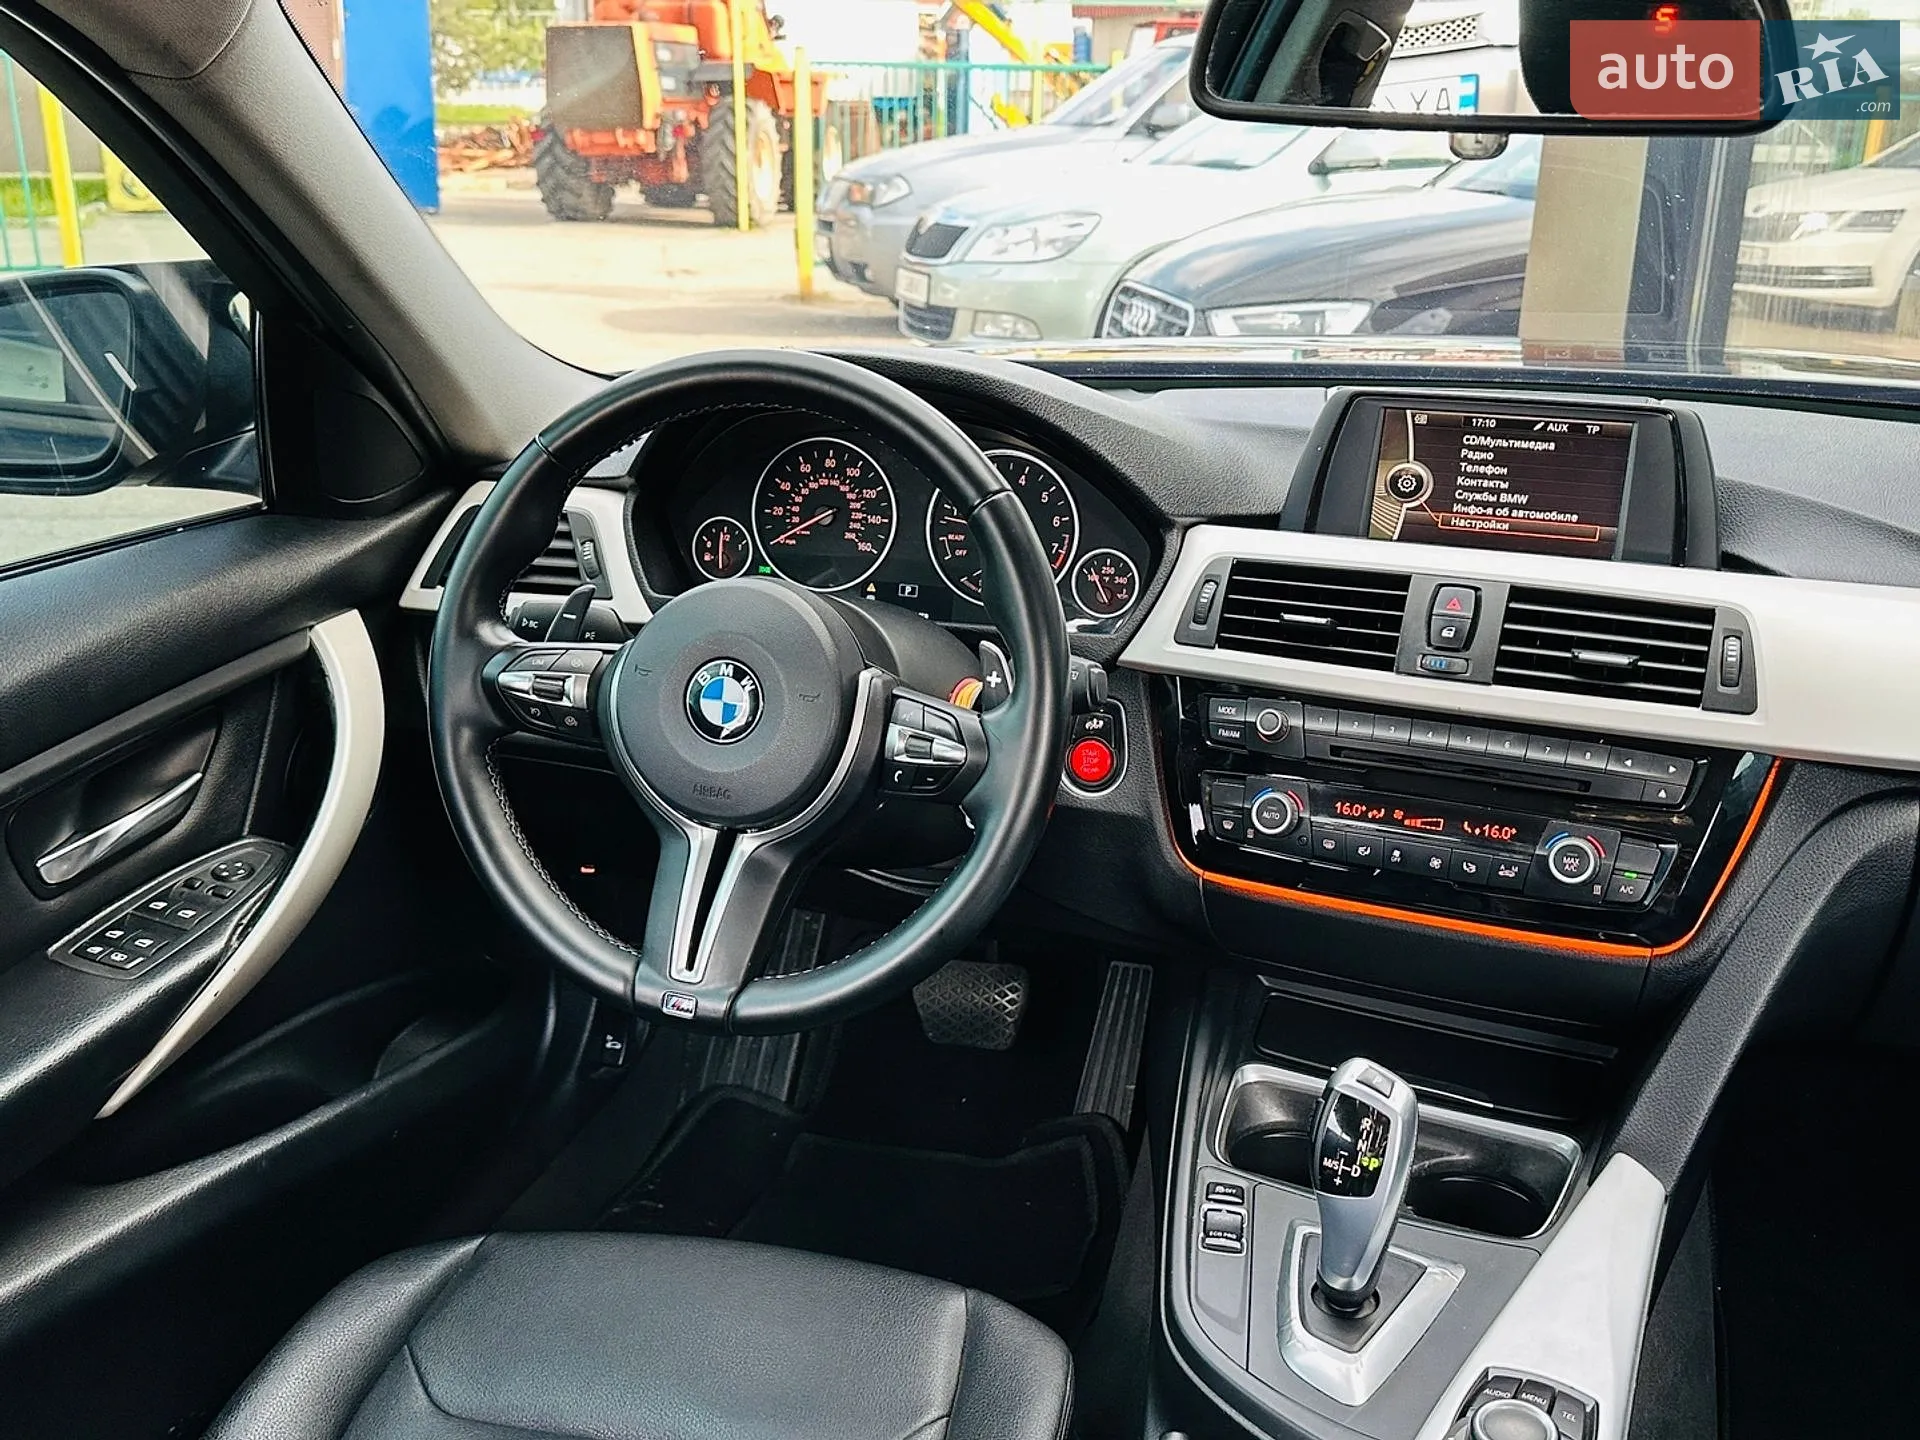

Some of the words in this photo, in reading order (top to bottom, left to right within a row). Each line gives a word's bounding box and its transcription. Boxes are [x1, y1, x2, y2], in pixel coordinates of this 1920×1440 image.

[1472, 418, 1496, 428] 17:10
[1547, 424, 1568, 433] AUX
[1586, 425, 1600, 434] TP
[1463, 435, 1556, 451] CD/Мультимедиа
[1461, 450, 1494, 461] Радио
[800, 464, 811, 472] 60
[824, 459, 836, 468] 80
[1460, 462, 1508, 476] Телефон
[846, 468, 860, 477] 100
[1019, 475, 1026, 486] 4
[1457, 476, 1509, 490] Контакты
[780, 482, 791, 491] 40
[863, 489, 876, 498] 120
[1041, 492, 1049, 502] 5
[1455, 490, 1498, 504] Службы
[1500, 492, 1528, 505] BMW
[772, 507, 783, 516] 20
[1453, 503, 1494, 517] Инфо-я
[1497, 506, 1509, 517] об
[1511, 510, 1578, 523] автомобиле
[867, 515, 881, 524] 140
[1053, 516, 1060, 527] 6
[1451, 516, 1510, 531] Настройки
[858, 542, 872, 551] 160
[1052, 543, 1059, 553] 7
[696, 663, 756, 692] BMW
[1218, 706, 1237, 715] MODE
[1262, 811, 1280, 820] AUTO
[1563, 856, 1580, 865] MAX
[1619, 885, 1634, 895] A/C
[1362, 1118, 1372, 1130] R
[1357, 1139, 1367, 1152] N
[1351, 1164, 1361, 1178] D
[1484, 1388, 1511, 1398] AUDIO
[1522, 1393, 1547, 1405] MENU
[1561, 1410, 1577, 1422] TEL
